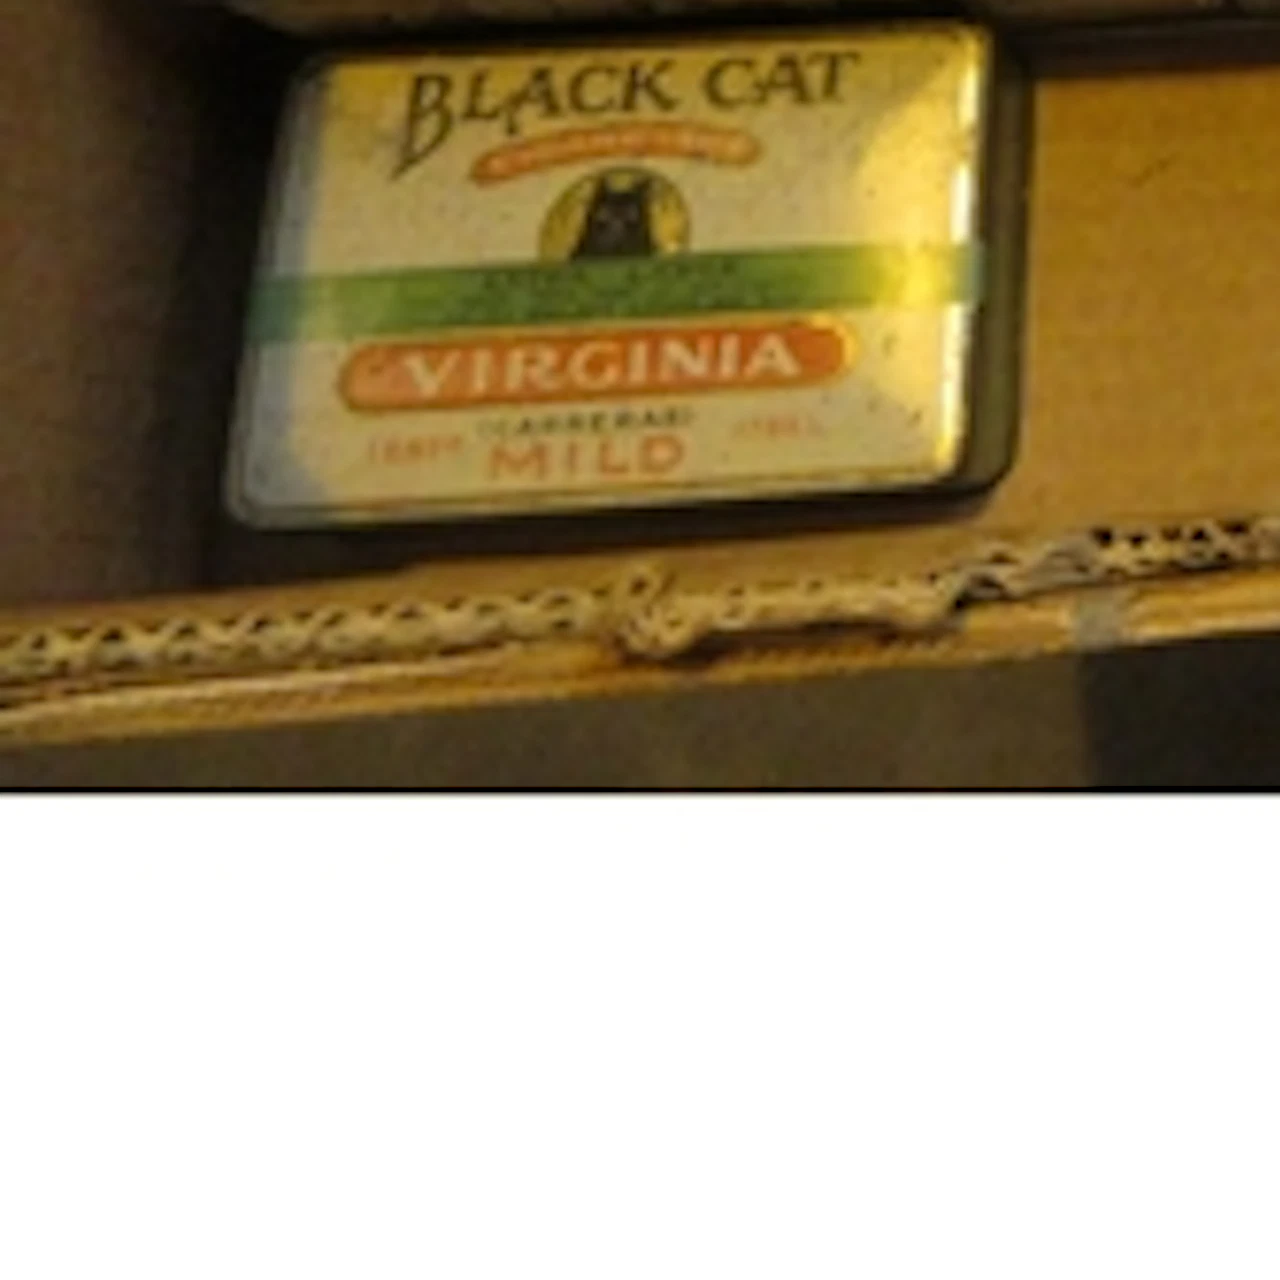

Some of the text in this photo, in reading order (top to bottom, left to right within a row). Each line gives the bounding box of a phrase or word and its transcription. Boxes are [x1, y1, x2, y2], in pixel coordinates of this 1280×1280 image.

[392, 57, 683, 181] BLACK
[703, 51, 861, 109] CAT
[403, 333, 802, 398] VIRGINIA
[487, 434, 686, 482] MILD
